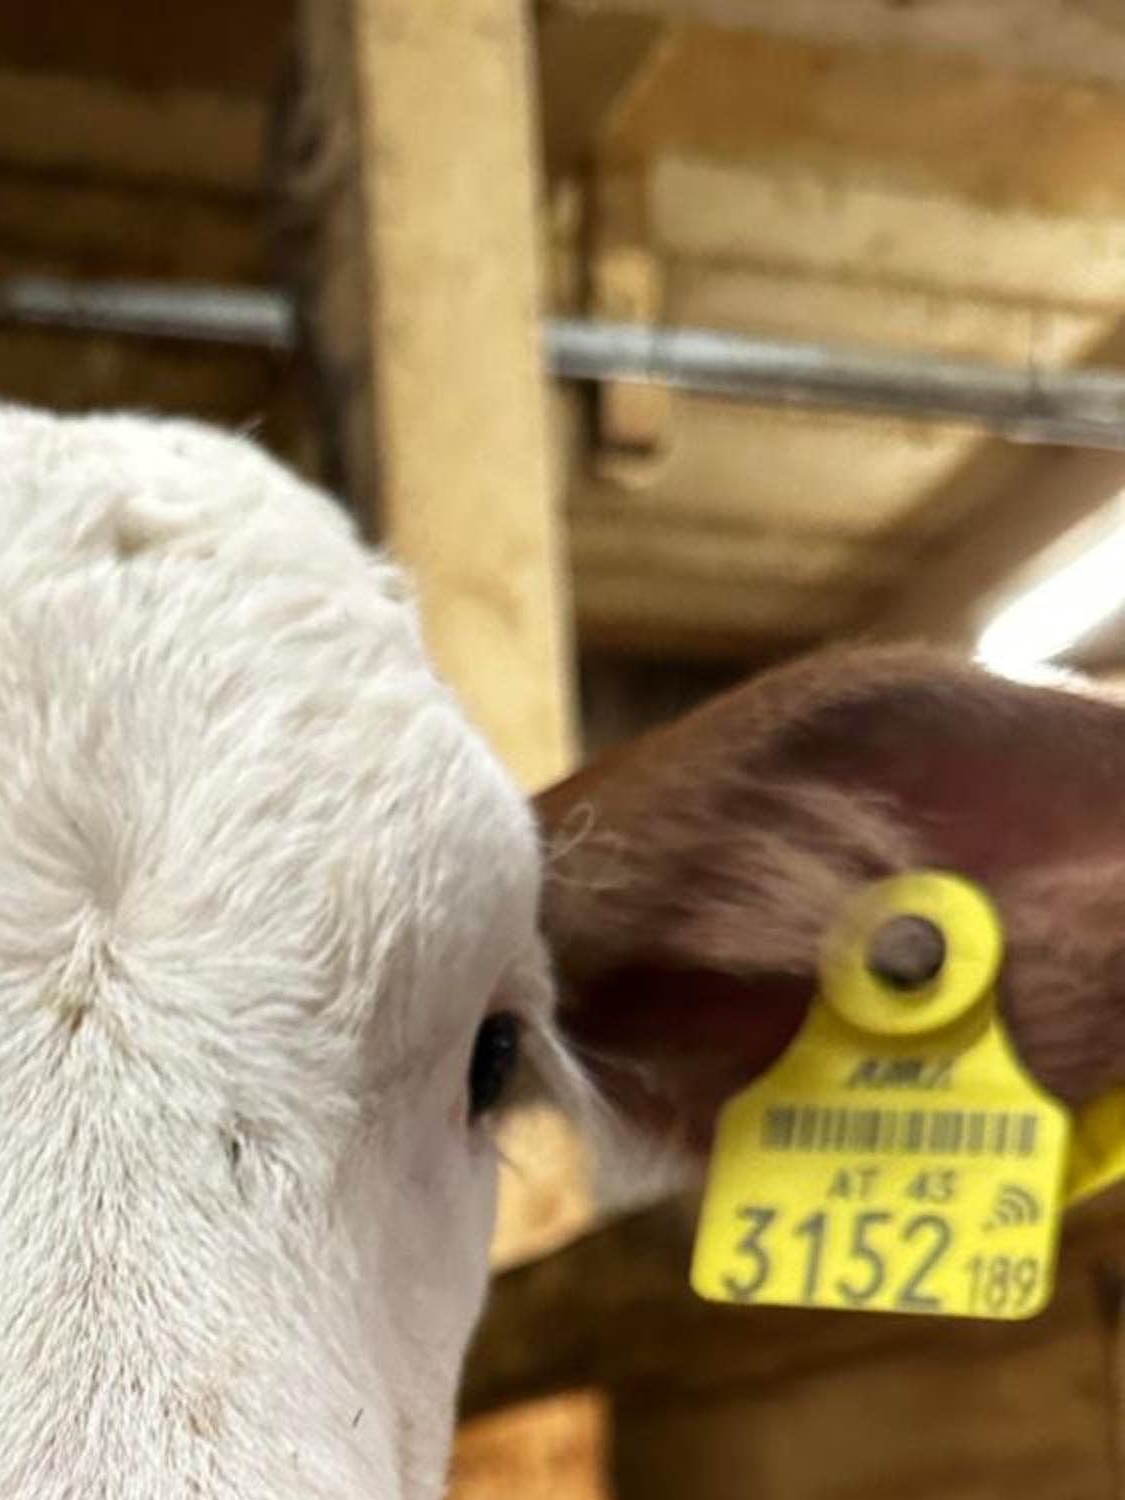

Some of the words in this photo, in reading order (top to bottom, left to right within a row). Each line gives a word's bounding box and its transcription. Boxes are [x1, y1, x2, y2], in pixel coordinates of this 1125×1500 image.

[829, 1167, 881, 1200] AT
[905, 1170, 958, 1203] 43
[722, 1205, 953, 1310] 3152
[967, 1256, 1039, 1316] 189
